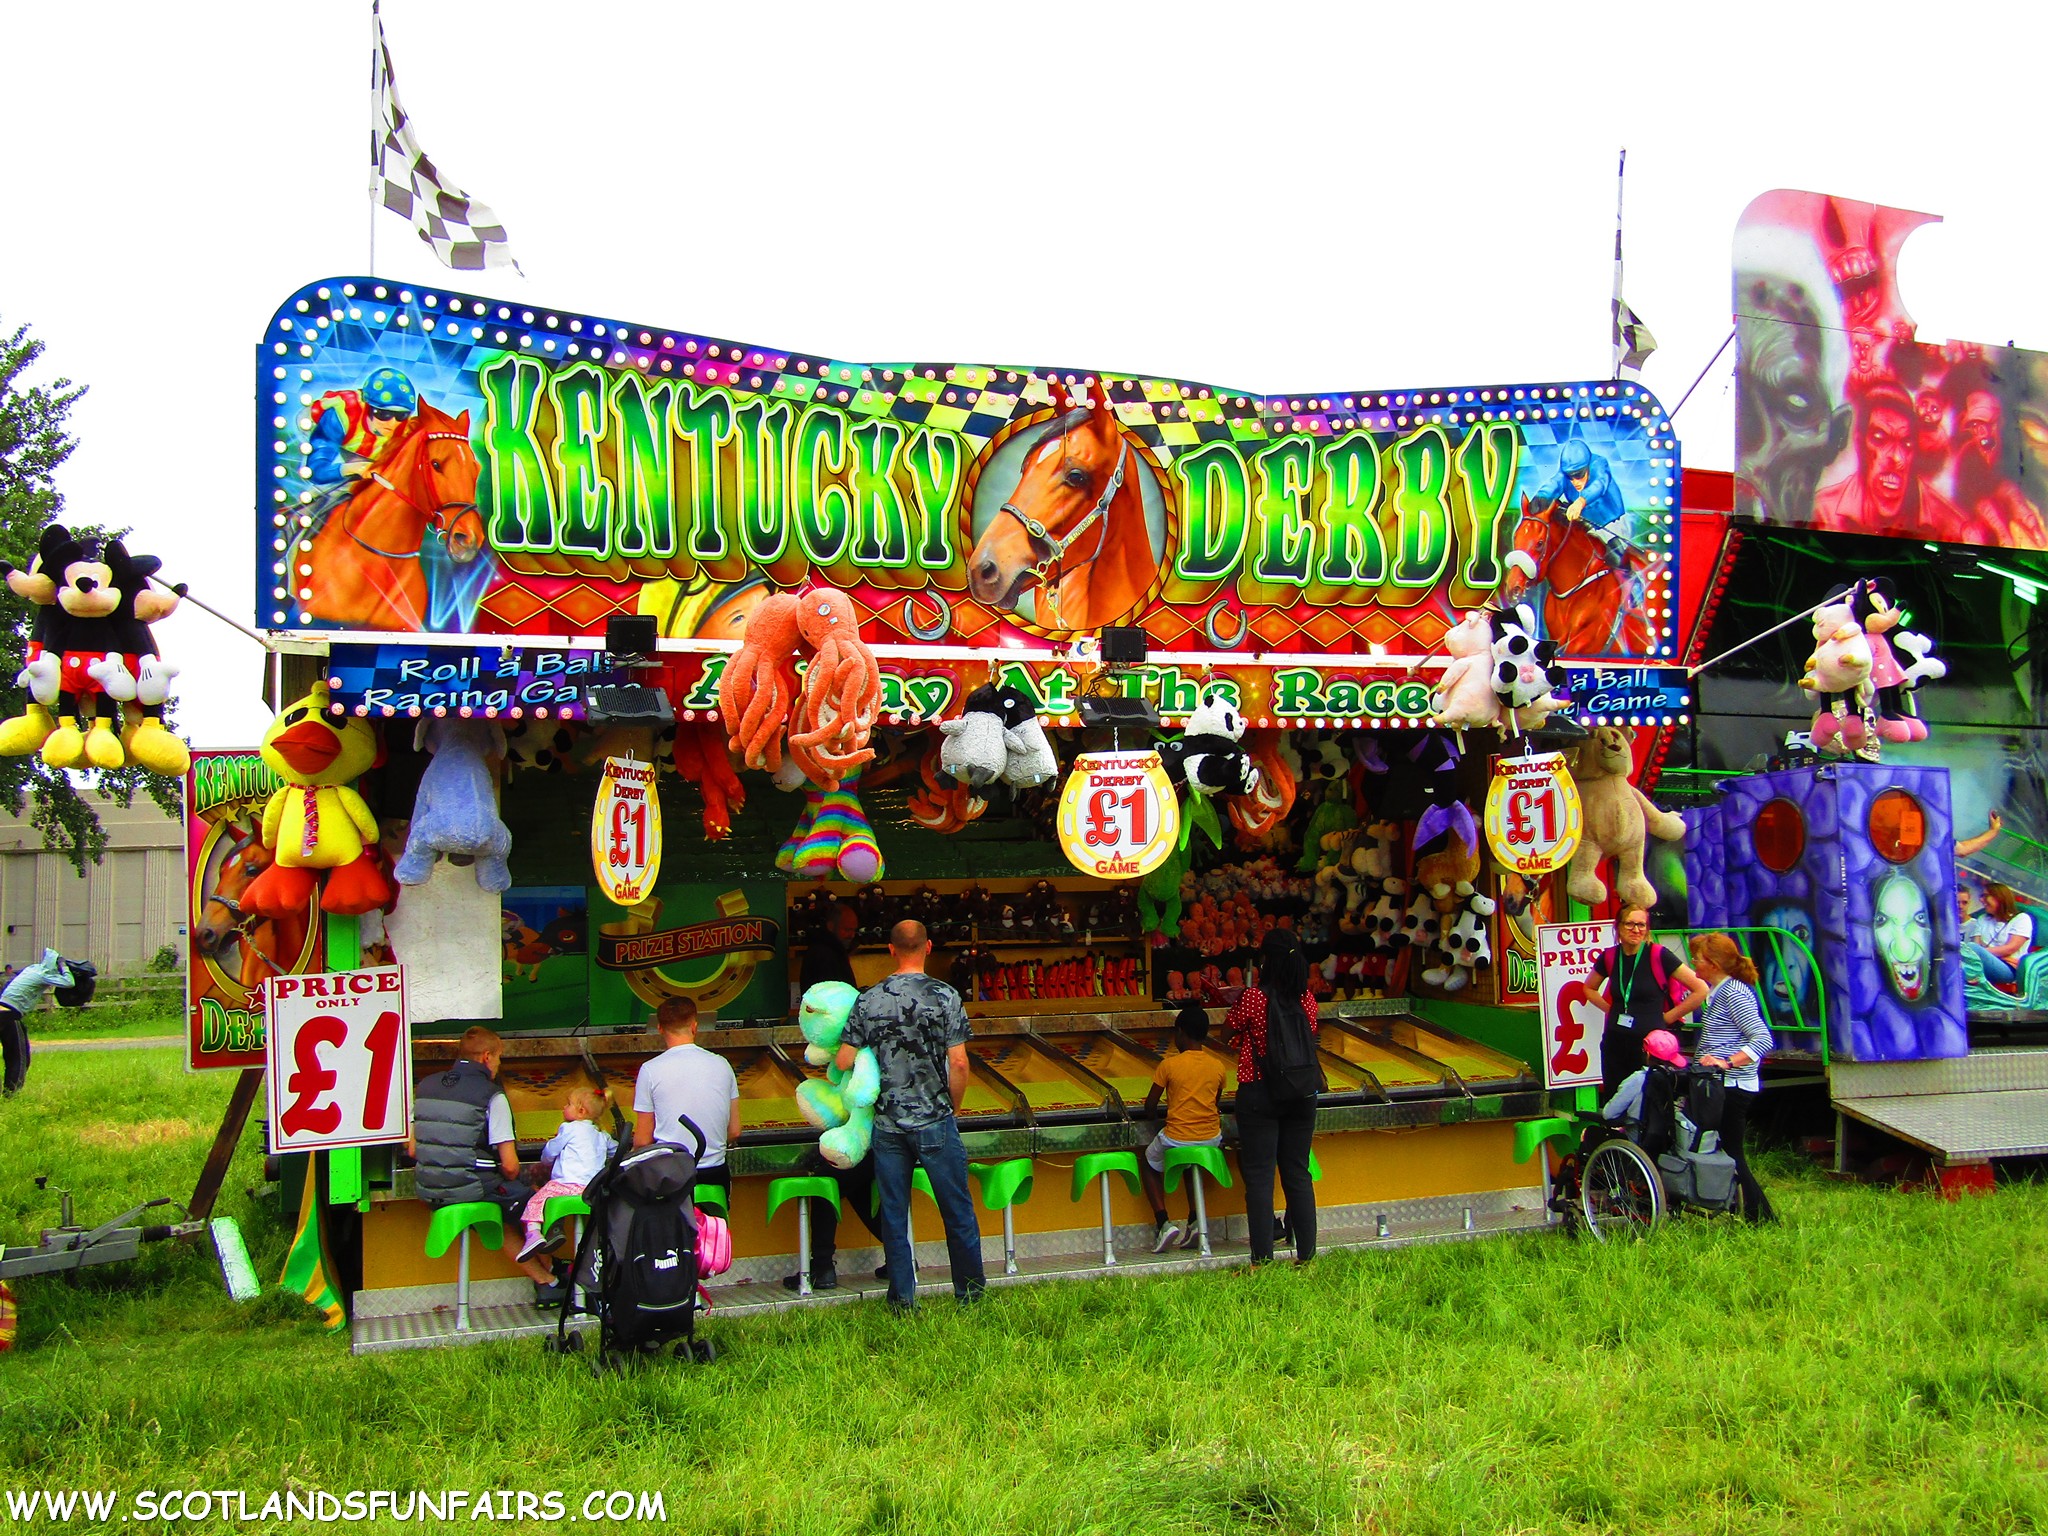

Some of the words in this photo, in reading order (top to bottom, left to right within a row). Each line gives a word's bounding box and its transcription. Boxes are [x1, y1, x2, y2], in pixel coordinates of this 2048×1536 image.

[481, 350, 963, 569] KENTUCKY
[1175, 421, 1518, 588] DERBY
[400, 656, 481, 683] Roll
[1597, 668, 1649, 691] Ball
[996, 661, 1077, 716] At
[1273, 666, 1441, 718] Race
[365, 688, 508, 712] Racing
[1587, 693, 1668, 713] Game
[605, 763, 655, 783] KENTUCKY
[1074, 758, 1160, 771] KENTUCKY
[1496, 760, 1565, 776] KENTUCKY
[1090, 775, 1144, 787] DERBY
[1508, 777, 1552, 790] DERBY
[613, 784, 646, 801] DERBY
[1085, 787, 1147, 847] £1
[1506, 788, 1558, 846] £1
[609, 800, 647, 868] £1
[1112, 851, 1123, 861] A
[1529, 848, 1538, 858] A
[1095, 860, 1140, 874] GAME
[1516, 857, 1553, 870] GAME
[624, 873, 631, 885] A
[614, 886, 640, 900] GAME
[615, 935, 673, 963] PRIZE
[678, 922, 763, 953] STATION
[1557, 927, 1602, 945] CUT
[1543, 948, 1603, 967] PRIC
[1568, 966, 1593, 975] ONL
[275, 972, 401, 1000] PRICE
[315, 997, 361, 1009] ONLY
[281, 1011, 401, 1138] £1
[655, 1257, 678, 1270] PUMA
